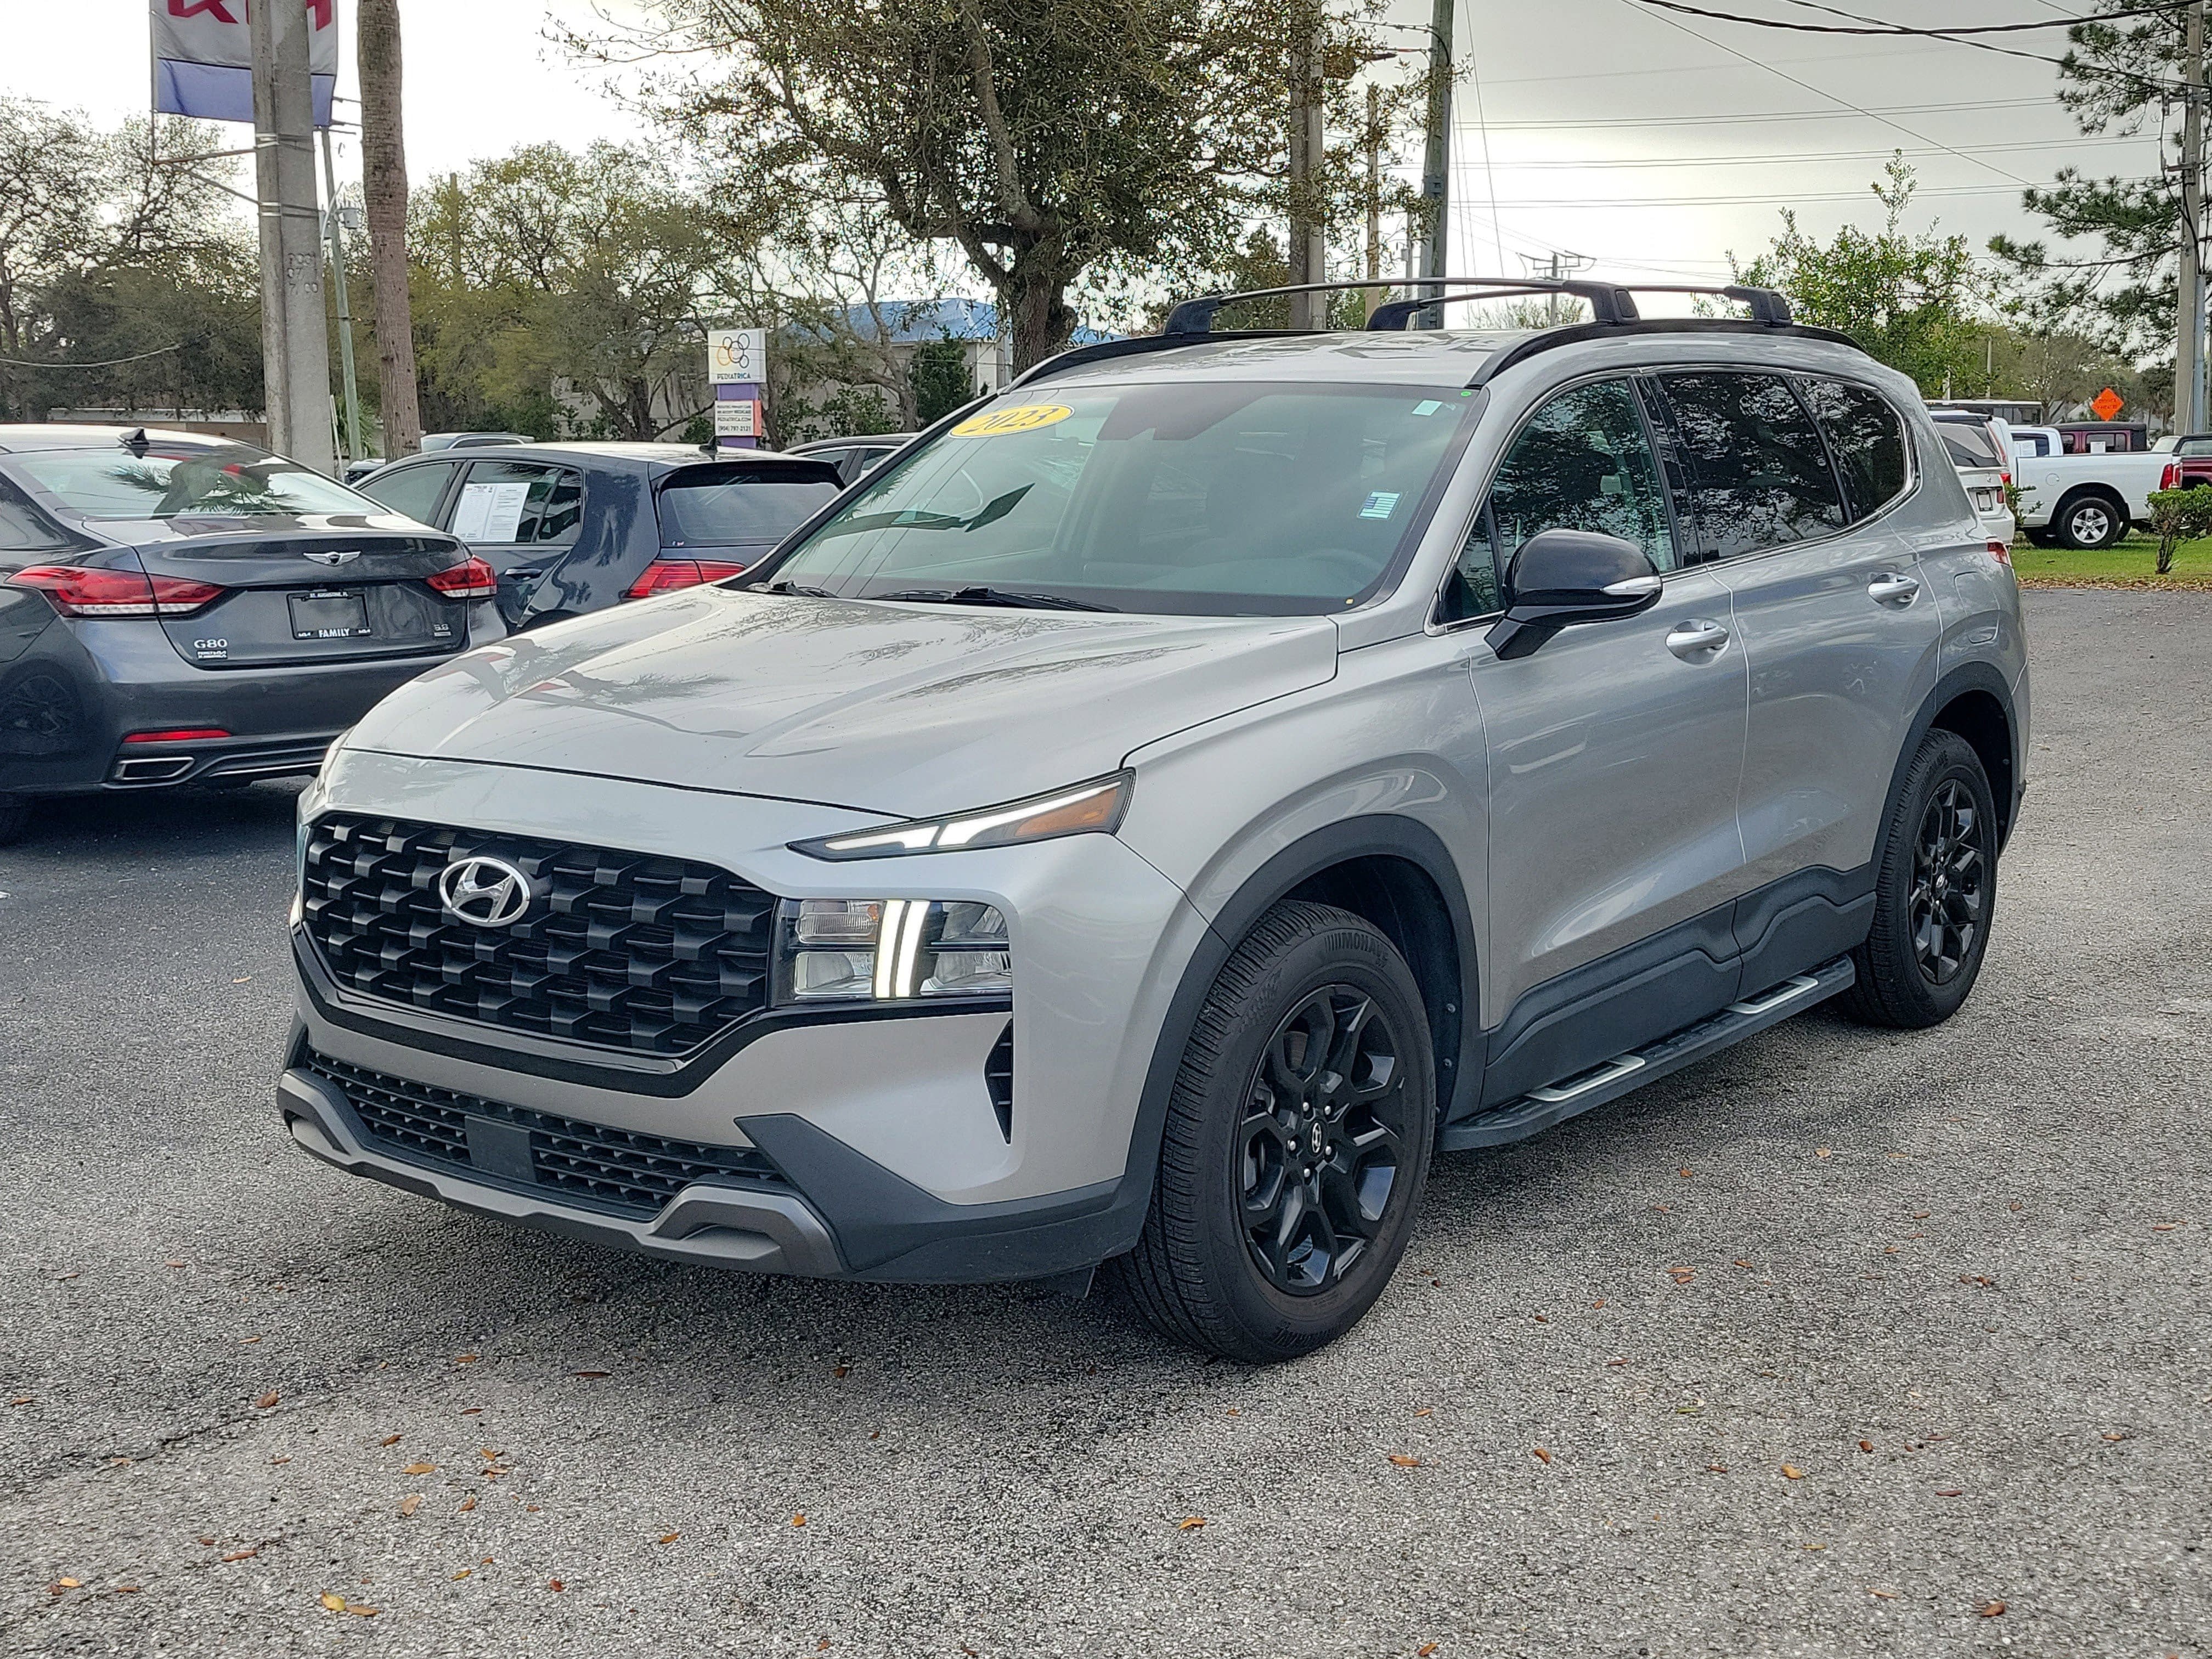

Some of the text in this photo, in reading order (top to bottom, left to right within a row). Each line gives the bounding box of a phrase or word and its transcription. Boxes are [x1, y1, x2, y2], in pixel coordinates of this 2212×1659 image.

[961, 408, 1059, 433] 2023
[318, 628, 350, 638] FAMILY
[194, 639, 228, 648] G80
